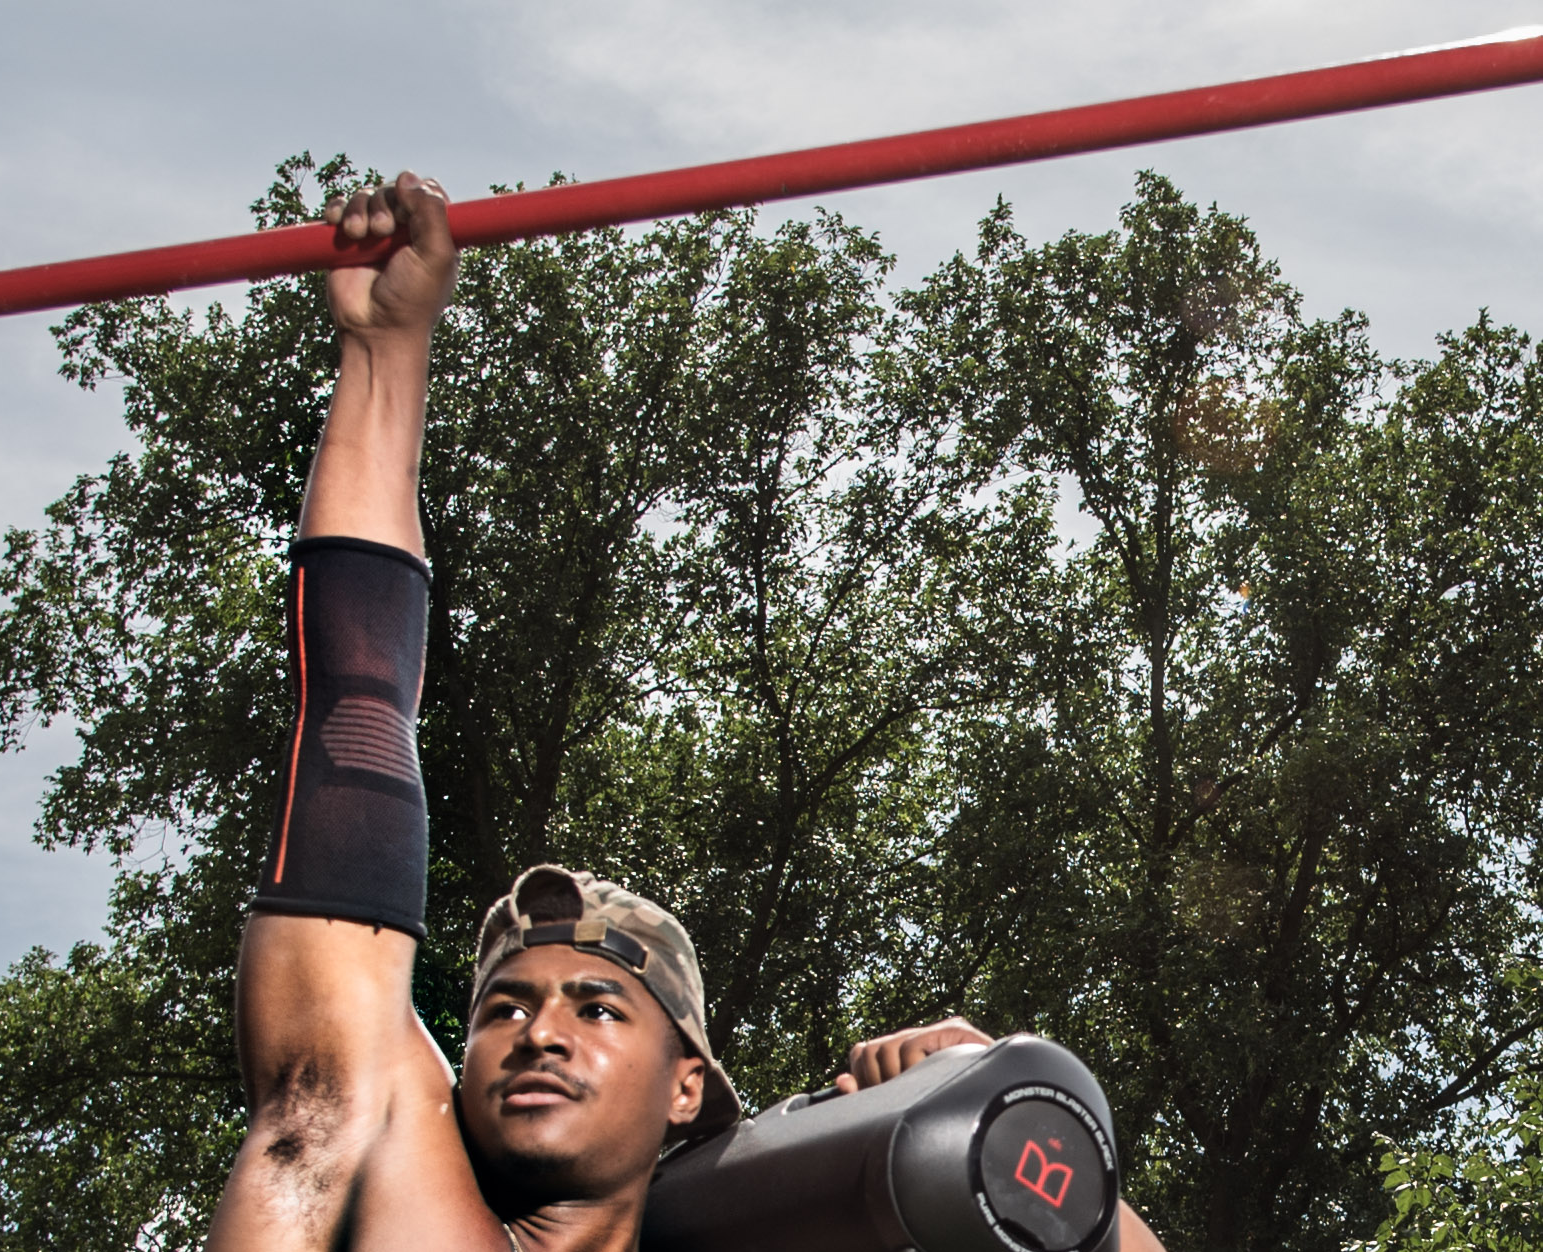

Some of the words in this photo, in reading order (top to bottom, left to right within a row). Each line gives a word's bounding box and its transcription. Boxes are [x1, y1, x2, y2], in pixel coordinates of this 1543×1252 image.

[1003, 1086, 1055, 1103] MONSTER
[1055, 1091, 1098, 1131] BLASTER
[1094, 1129, 1114, 1171] BLACK
[976, 1192, 996, 1226] PURE
